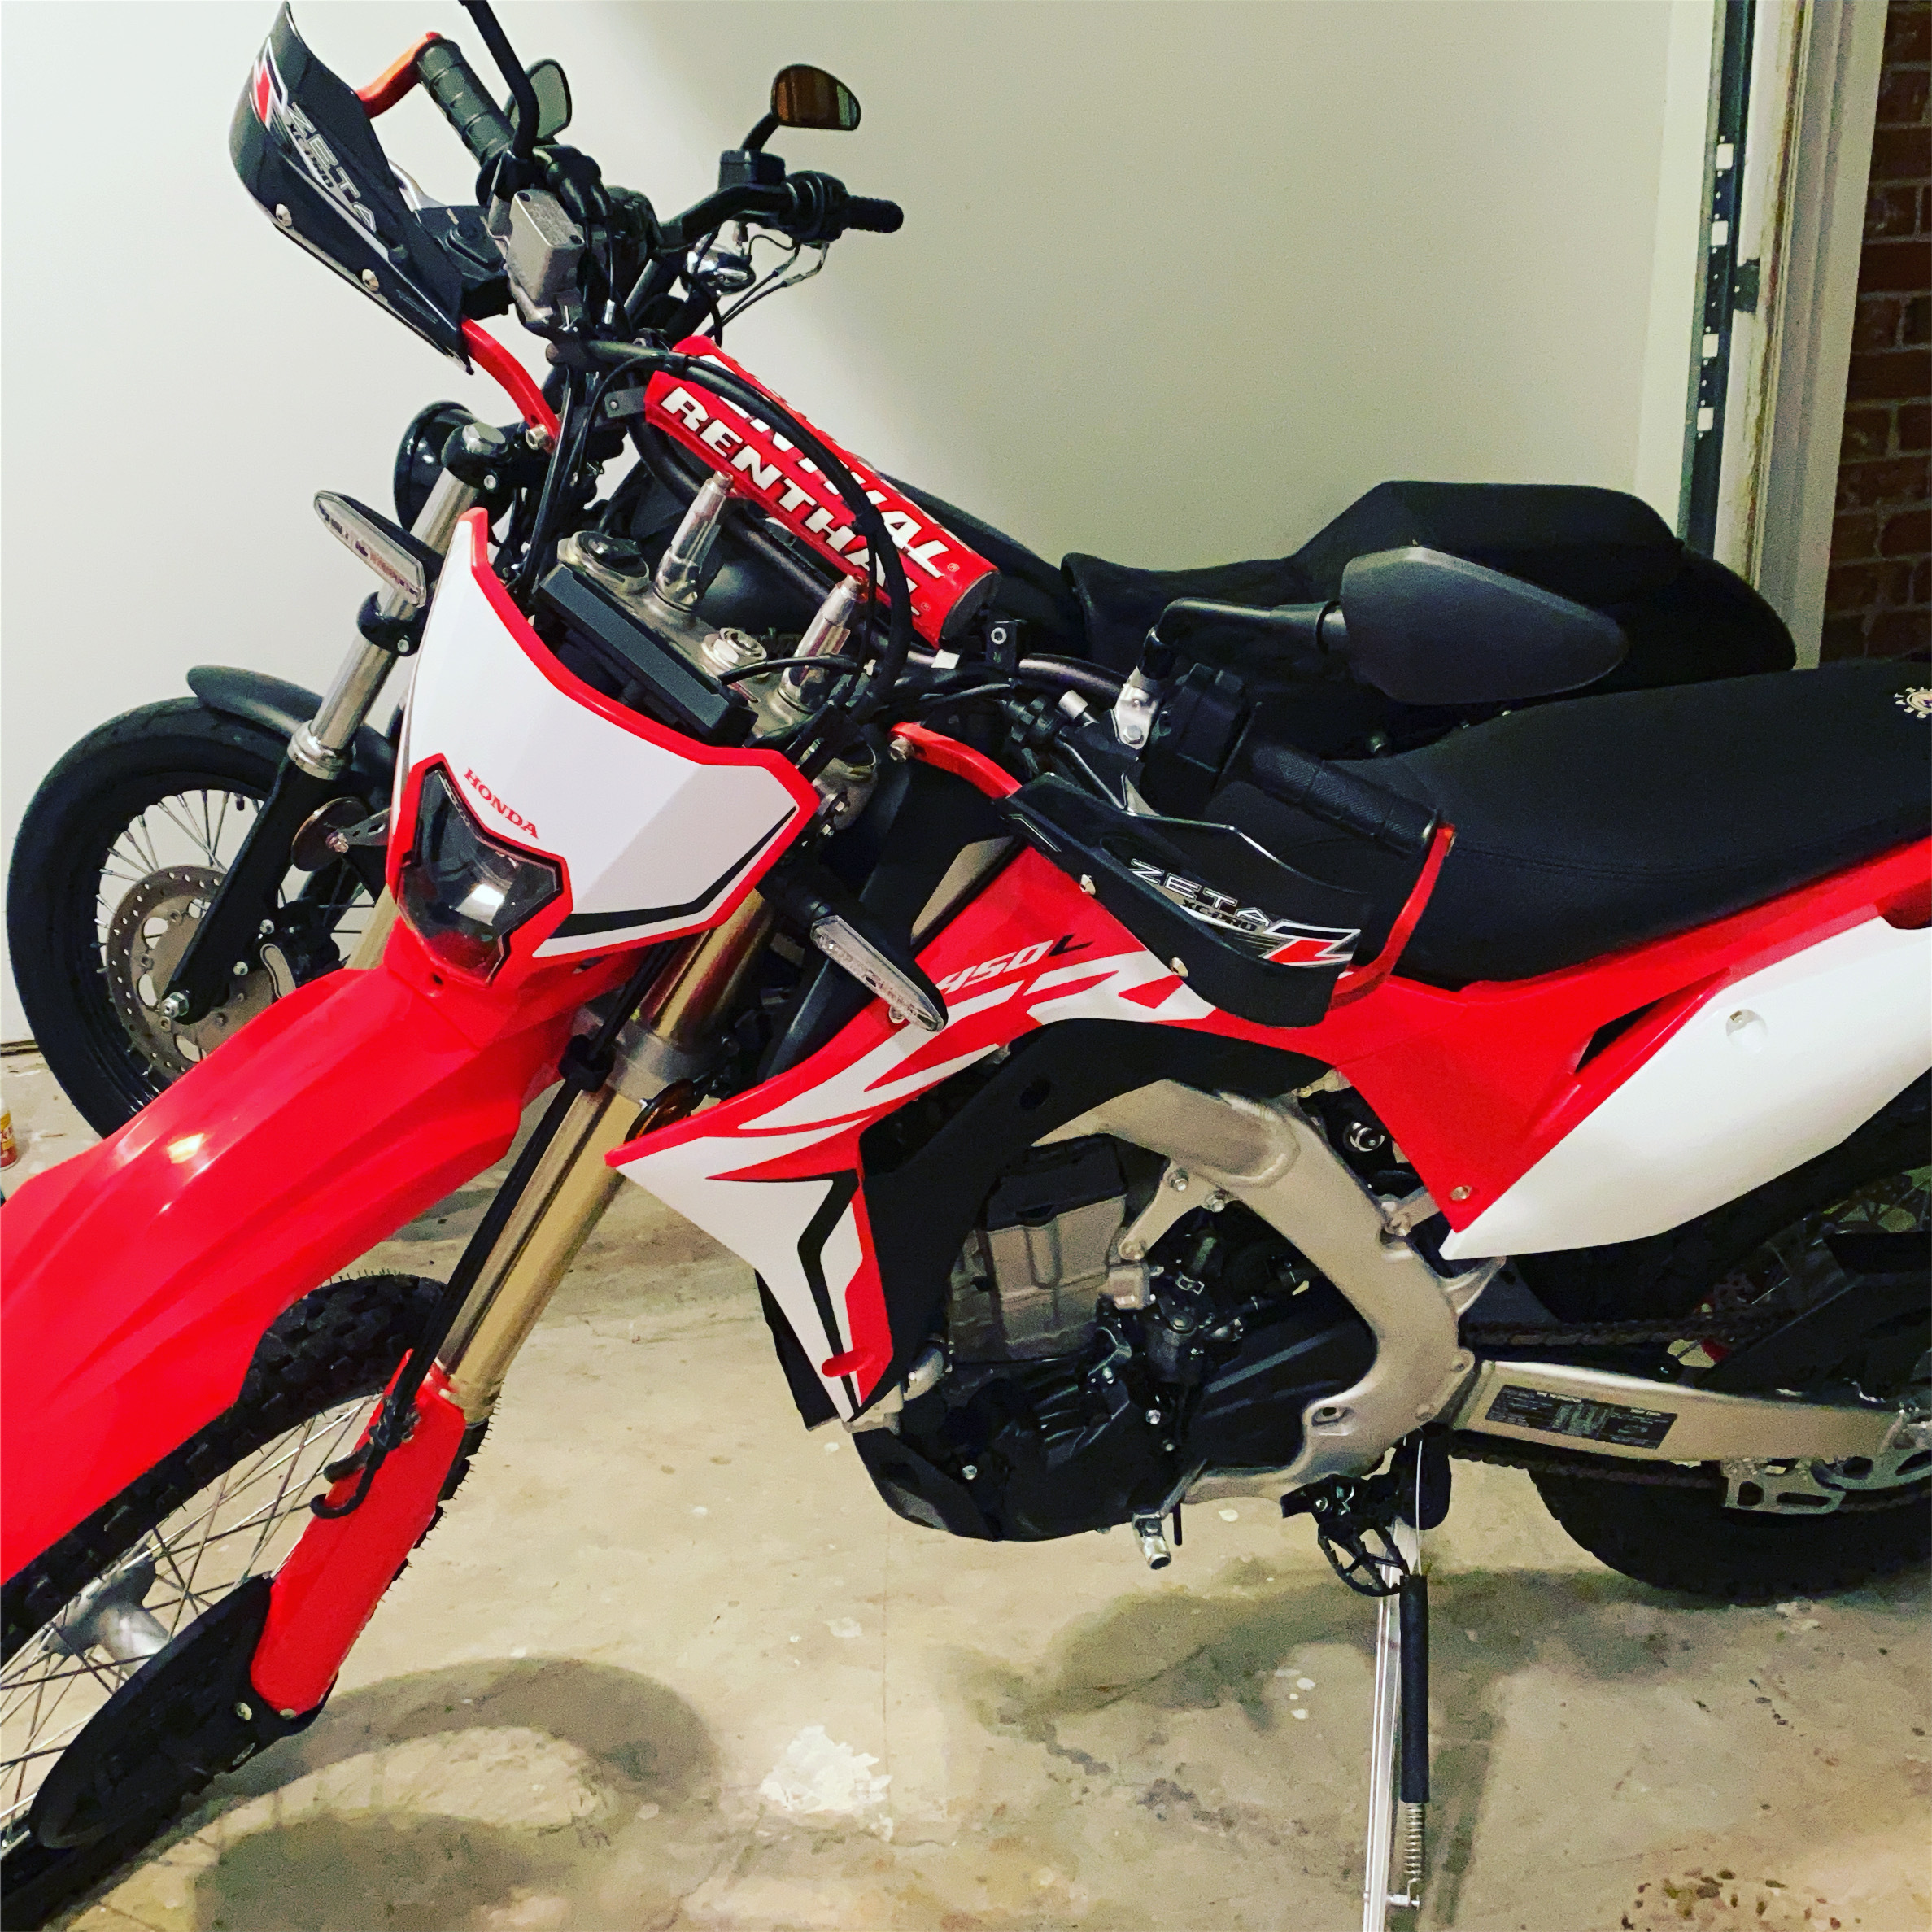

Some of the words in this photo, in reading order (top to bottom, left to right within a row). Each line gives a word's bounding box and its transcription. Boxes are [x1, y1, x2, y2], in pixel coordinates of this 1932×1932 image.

[661, 386, 920, 616] RENTHA
[464, 768, 538, 839] HONDA
[1130, 858, 1271, 927] ZETA
